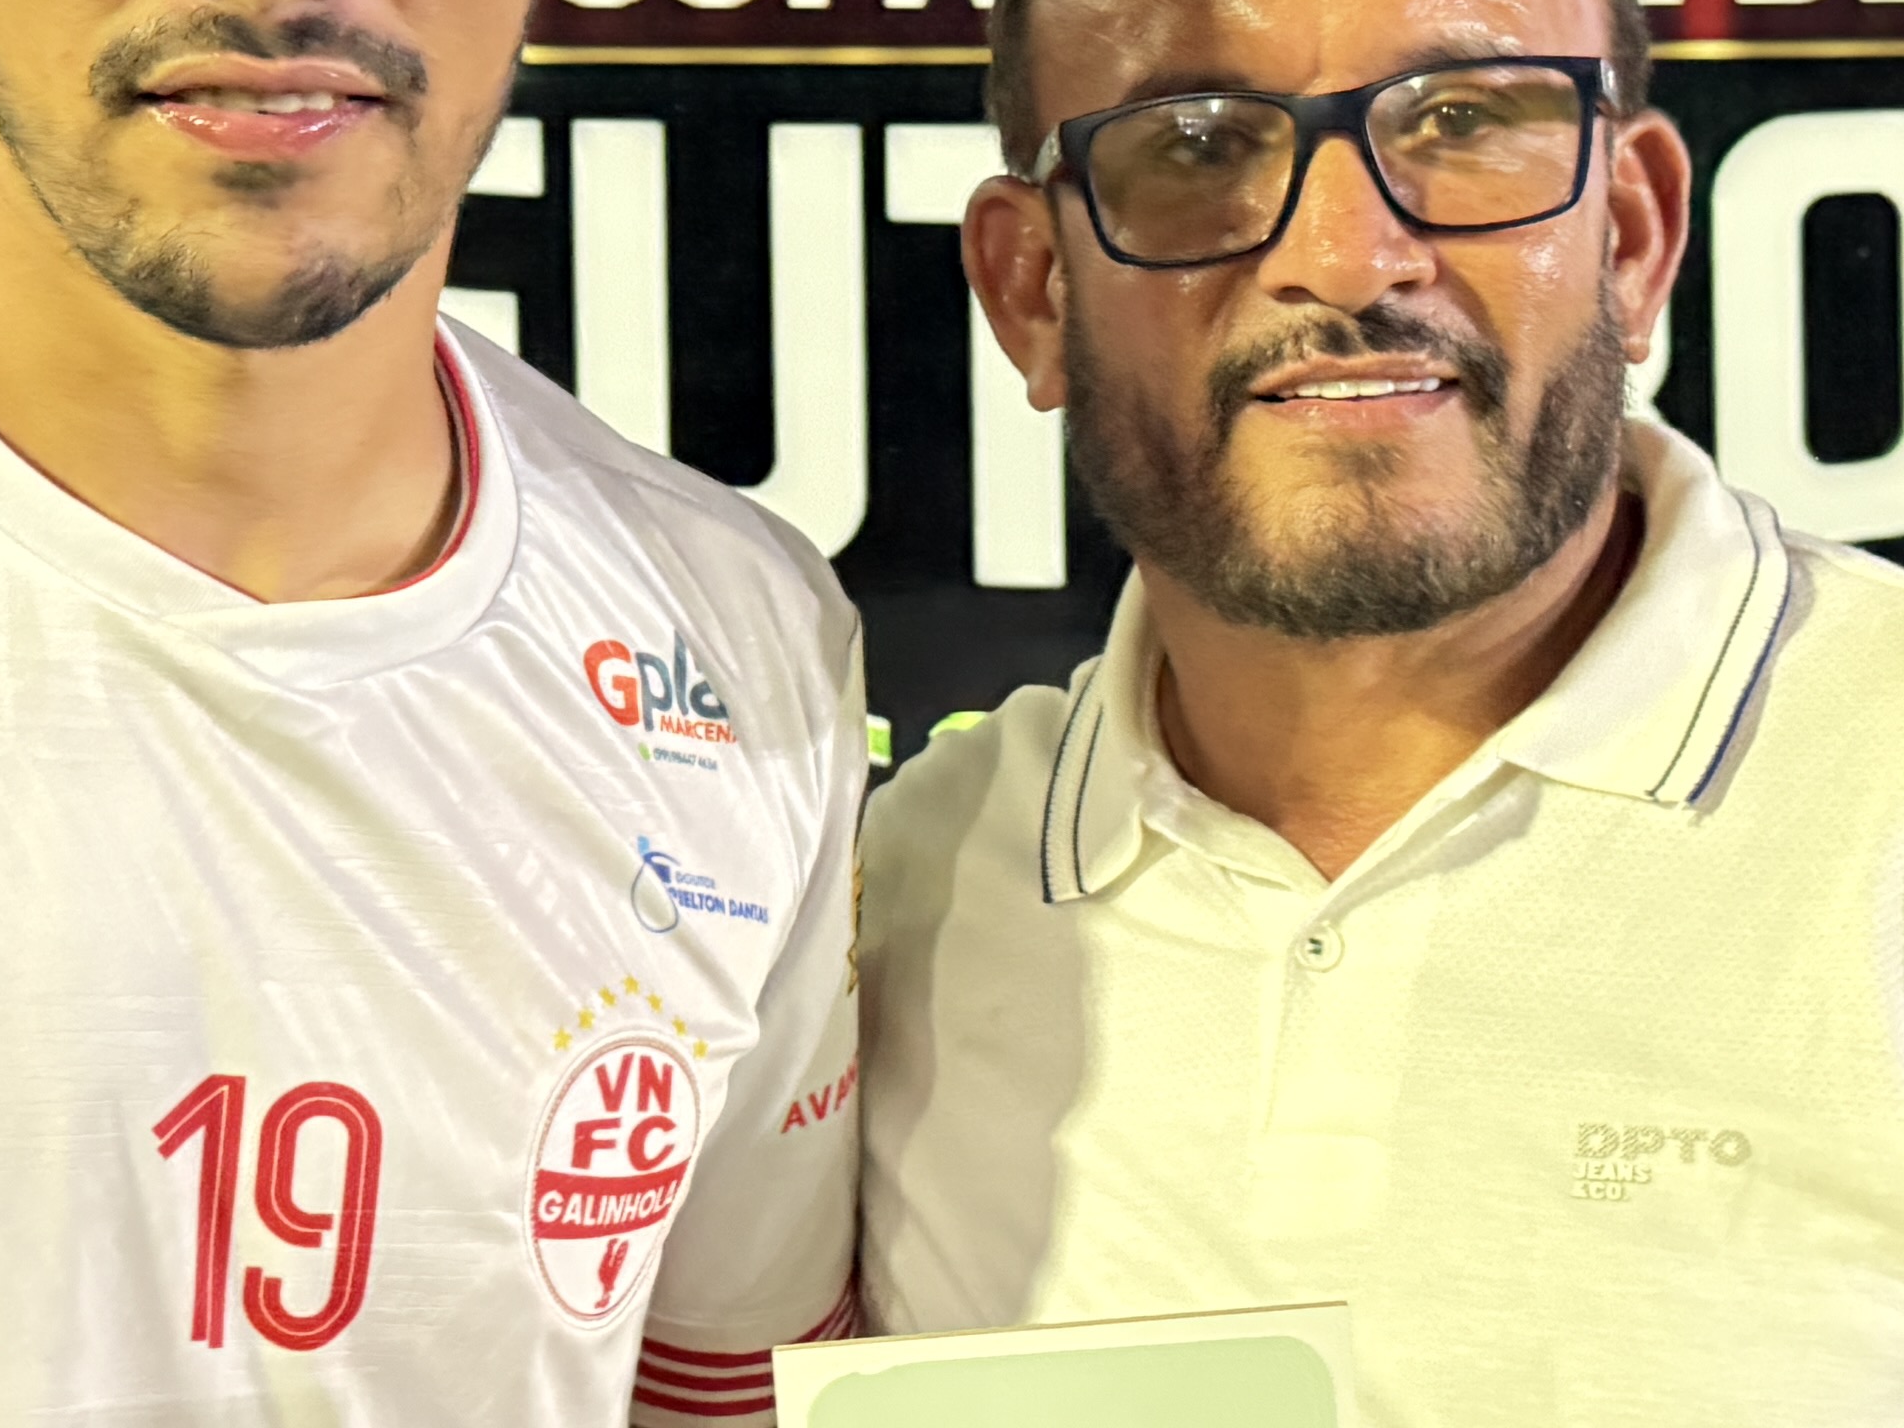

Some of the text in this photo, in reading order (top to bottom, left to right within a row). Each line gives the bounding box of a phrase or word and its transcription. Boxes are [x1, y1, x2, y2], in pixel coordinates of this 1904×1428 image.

[594, 1052, 675, 1114] VN
[571, 1114, 678, 1172] FC
[1575, 1122, 1753, 1168] DPTO
[1571, 1160, 1653, 1185] JEANS
[152, 1073, 383, 1352] 19
